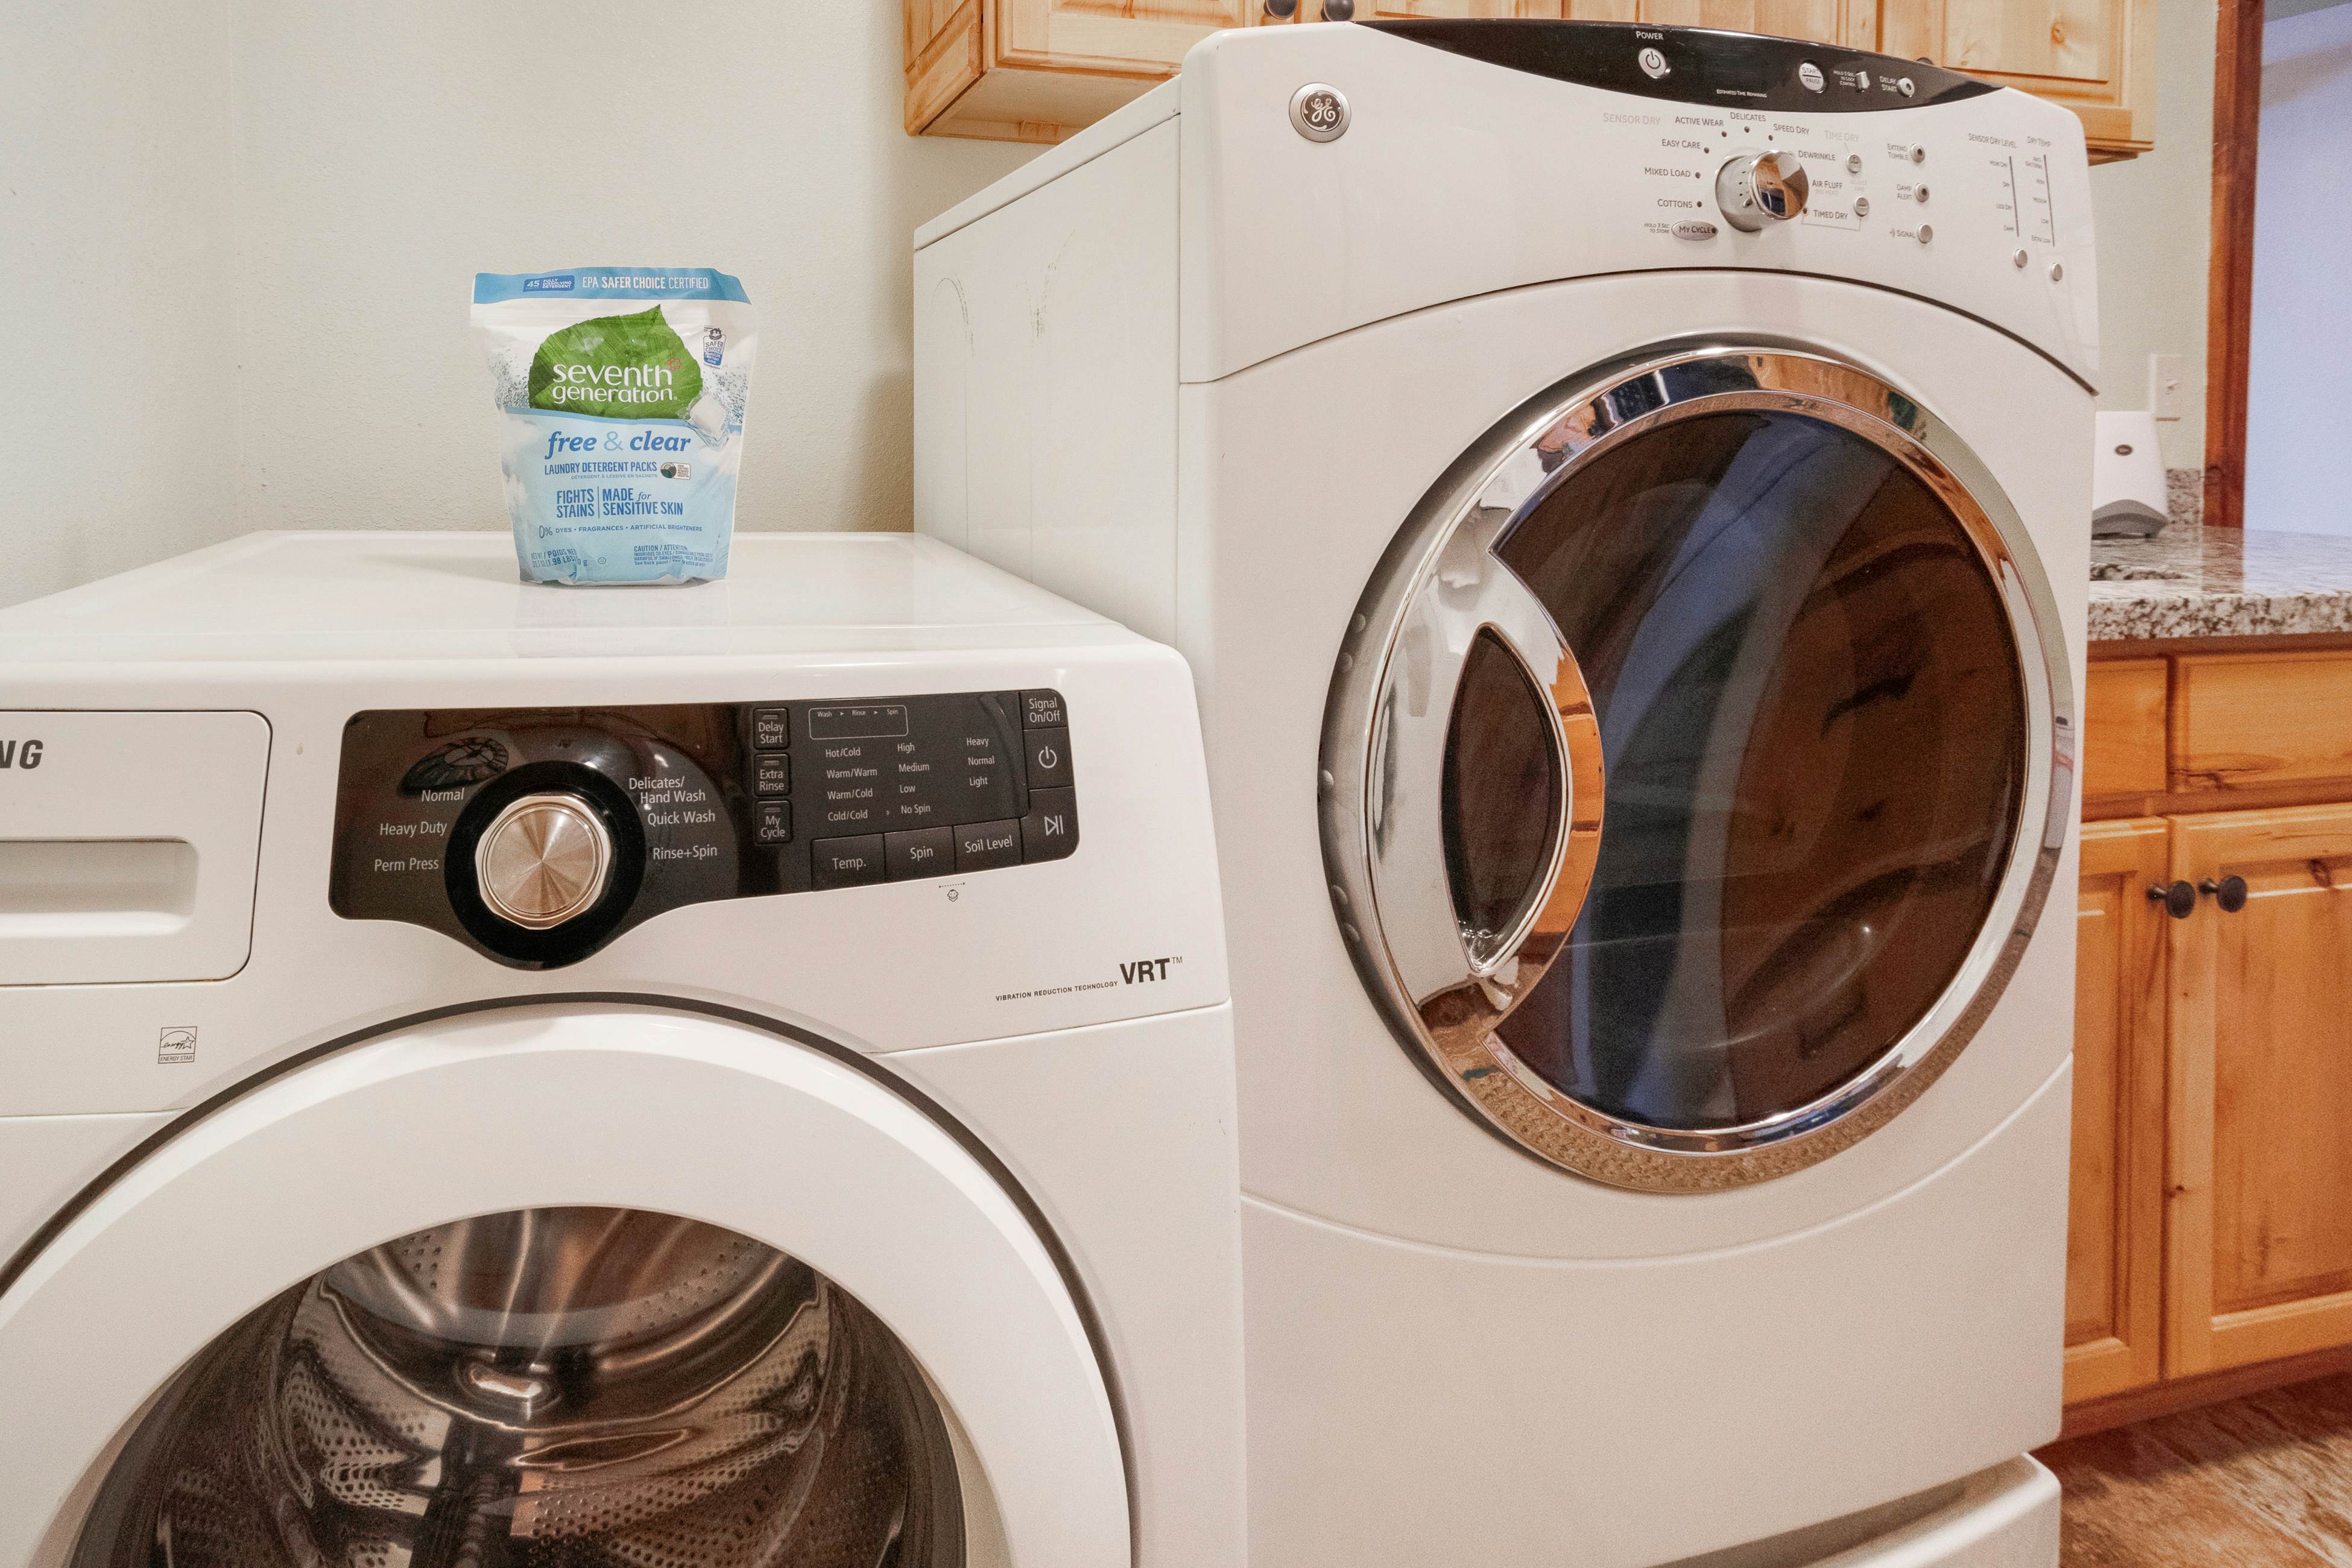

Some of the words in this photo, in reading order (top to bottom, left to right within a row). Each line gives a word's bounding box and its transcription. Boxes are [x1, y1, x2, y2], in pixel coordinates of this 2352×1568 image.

[1636, 31, 1664, 40] POWER
[1881, 84, 1897, 92] START
[1603, 113, 1640, 124] SENSOR
[1643, 115, 1661, 125] DRY
[1675, 116, 1701, 125] ACTIVE
[1702, 118, 1724, 127] WEAR
[1730, 112, 1766, 122] DELICATES
[1773, 124, 1795, 133] SPEED
[1796, 126, 1810, 134] DRY
[1824, 130, 1842, 141] TIME
[1844, 132, 1860, 142] DRY
[1968, 133, 1989, 143] SENSOR
[1990, 136, 2002, 145] DRY
[2002, 139, 2017, 148] LEVEL
[1661, 139, 1680, 148] EASY
[1681, 141, 1701, 150] CARE
[1798, 150, 1836, 161] DEWRINKLE
[1888, 151, 1909, 160] TUMBLE
[1645, 168, 1668, 176] MIXED
[1671, 169, 1690, 177] LOAD
[1824, 180, 1843, 189] FLUFF
[1657, 199, 1693, 208] COTTONS
[1813, 209, 1833, 218] TIMED
[1896, 230, 1916, 239] SIGNAL
[583, 277, 598, 288] EPA
[602, 277, 631, 288] SAFER
[633, 277, 666, 289] CHOICE
[668, 277, 709, 290] CERTIFIED
[552, 364, 672, 387] seventh
[552, 385, 673, 405] generation
[545, 431, 597, 460] free
[604, 431, 624, 451] &
[630, 431, 691, 452] clear
[545, 462, 580, 475] LAUNDRY
[582, 461, 629, 473] DETERGENT
[631, 461, 657, 472] PACKS
[557, 488, 594, 504] FIGHTS
[603, 488, 633, 501] MADE
[637, 492, 651, 502] for
[557, 504, 595, 519] STAINS
[603, 502, 658, 516] SENSITIVE
[660, 502, 683, 516] SKIN
[539, 525, 553, 539] 0%
[548, 549, 567, 558] POIDS
[1029, 698, 1057, 712] Signal
[1029, 710, 1060, 723] On/Off
[759, 722, 783, 733] Delay
[760, 734, 783, 744] Start
[966, 737, 989, 747] Heavy
[826, 747, 861, 757] Hot/Cold
[897, 743, 915, 754] High
[968, 756, 995, 765] Normal
[826, 768, 877, 779] Warm/Warm
[899, 763, 930, 773] Medium
[760, 770, 783, 779] Extra
[629, 776, 684, 789] Delicates/
[759, 781, 784, 791] Rinse
[969, 777, 988, 788] Light
[422, 788, 465, 802] Normal
[827, 788, 873, 800] Warm/Cold
[900, 785, 915, 793] Low
[640, 791, 670, 804] Hand
[674, 789, 706, 802] Wash
[827, 809, 868, 821] Cold/Cold
[901, 805, 913, 814] No
[914, 804, 931, 816] Spin
[648, 811, 680, 827] Quick
[683, 809, 715, 823] Wash
[765, 816, 780, 827] My
[380, 823, 417, 838] Heavy
[420, 821, 447, 836] Duty
[760, 827, 785, 840] Cycle
[965, 839, 984, 853] Soil
[987, 835, 1013, 850] Level
[653, 844, 718, 860] Rinse+Spin
[910, 846, 934, 861] Spin
[374, 859, 405, 872] Perm
[409, 858, 439, 870] Press
[832, 857, 867, 870] Temp.
[996, 991, 1032, 1002] VIBRATION
[1034, 987, 1072, 997] REDUCTION
[1075, 981, 1118, 991] TECHNOLOGY
